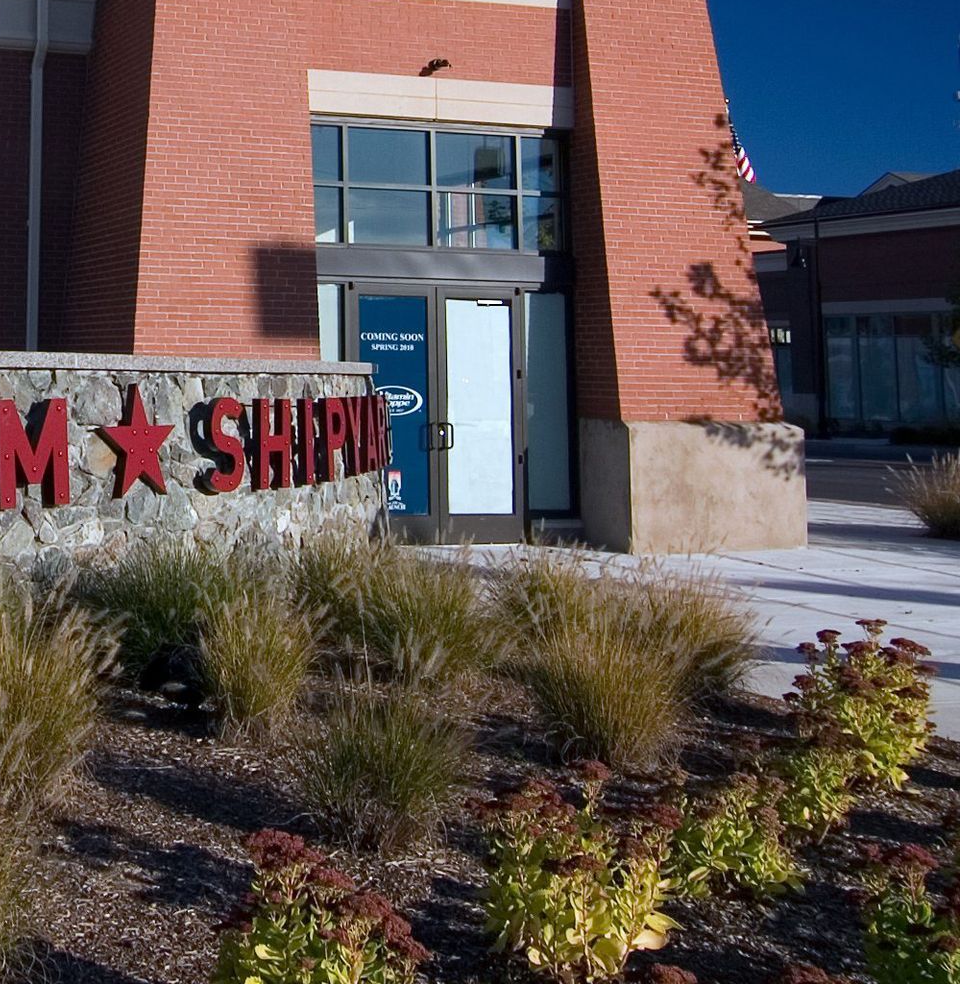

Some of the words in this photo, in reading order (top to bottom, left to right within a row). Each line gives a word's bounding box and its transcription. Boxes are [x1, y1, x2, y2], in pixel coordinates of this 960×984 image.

[360, 332, 398, 341] COMING
[399, 333, 424, 341] SOON
[371, 343, 399, 351] SPRING
[204, 396, 389, 494] SHIPYAR
